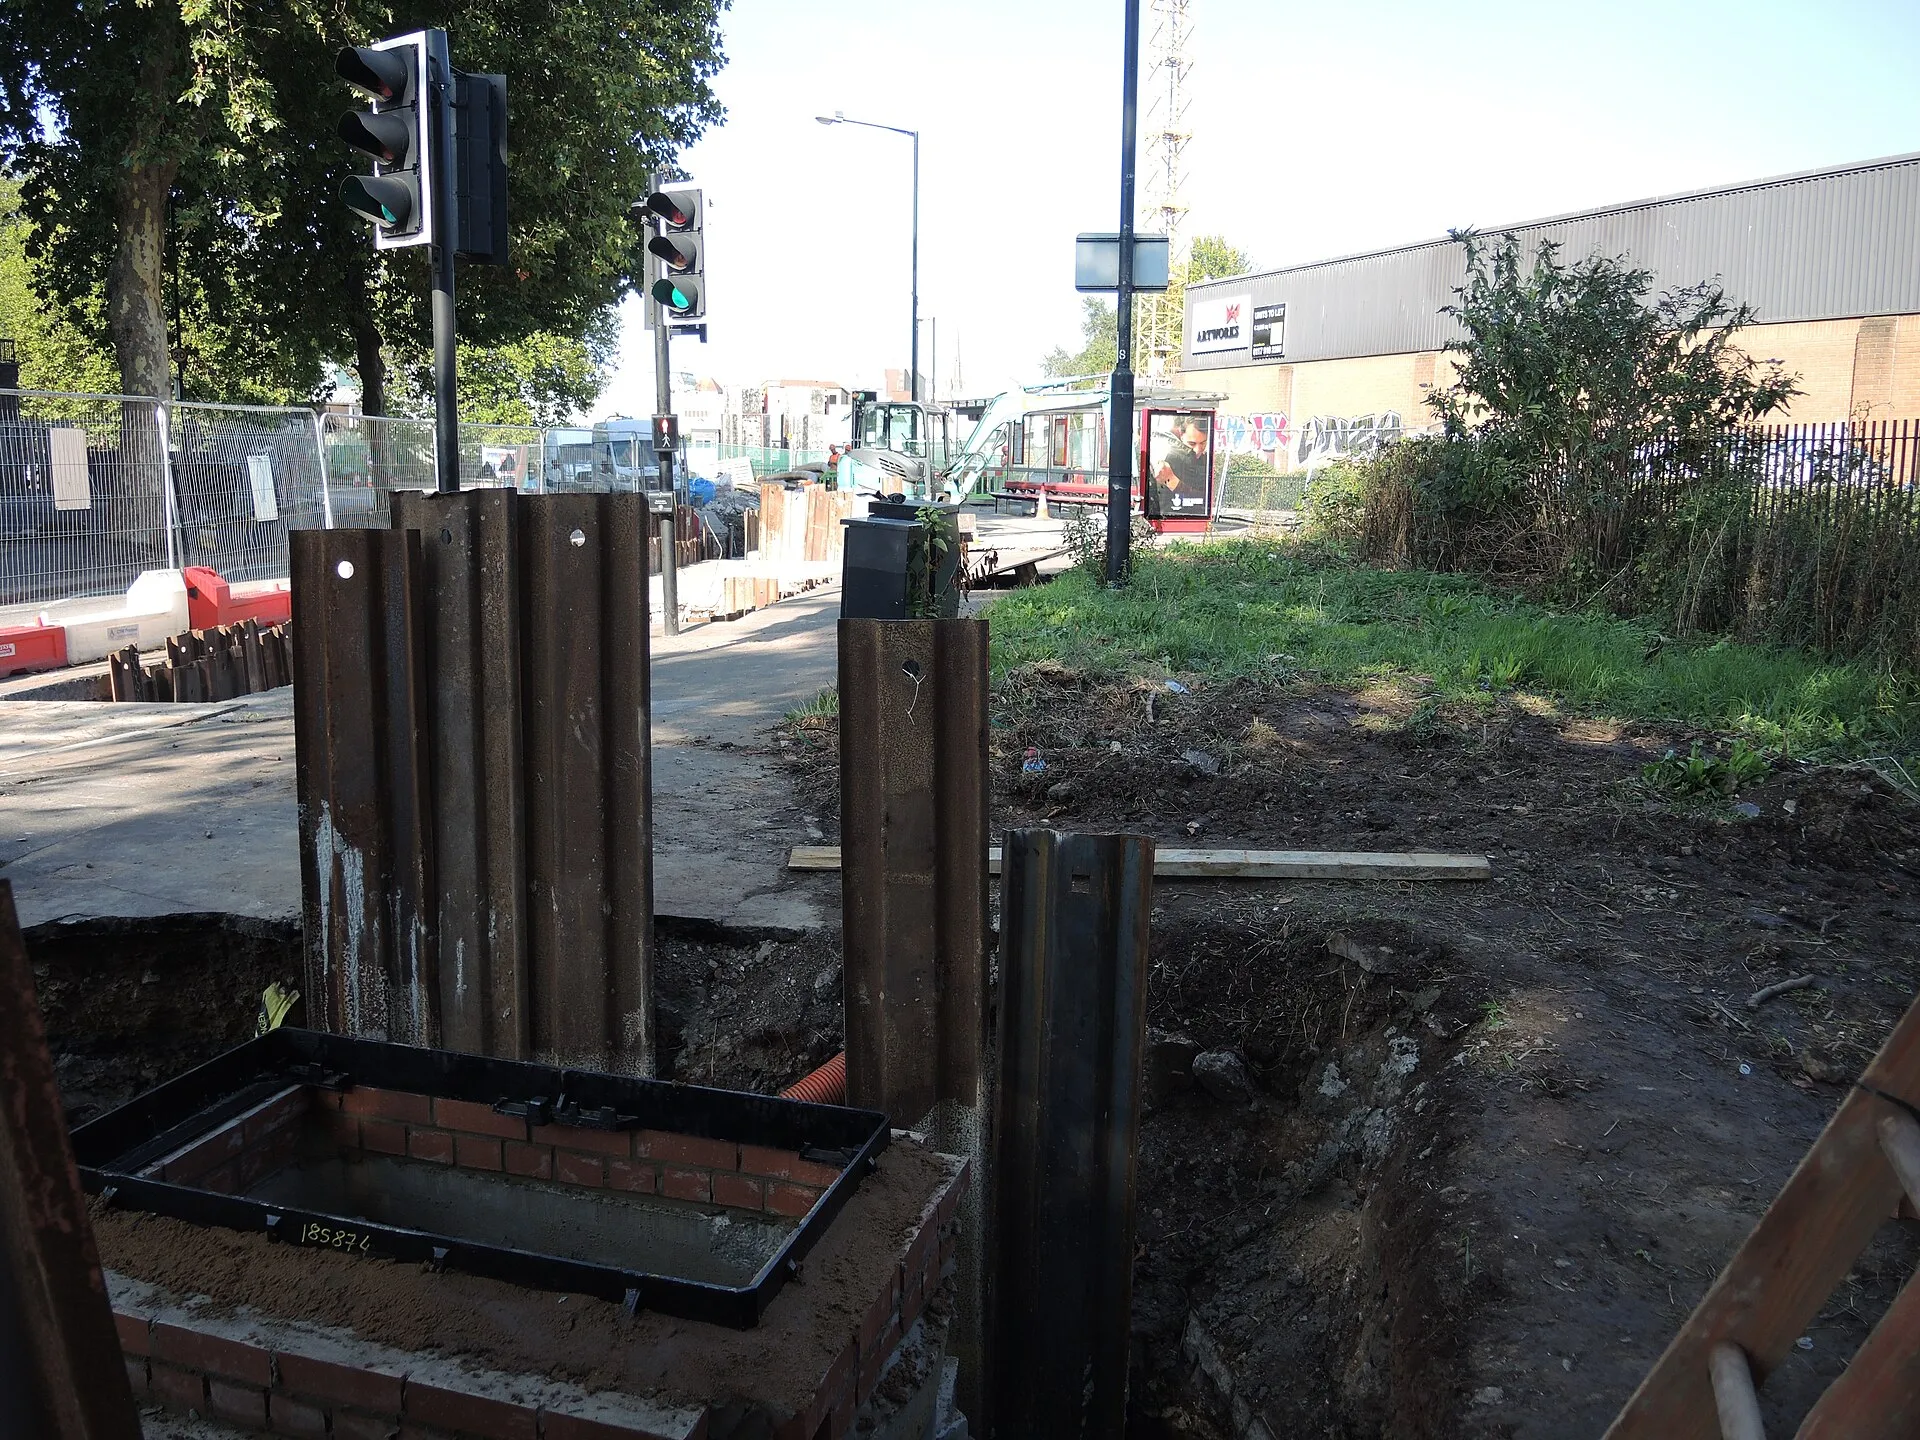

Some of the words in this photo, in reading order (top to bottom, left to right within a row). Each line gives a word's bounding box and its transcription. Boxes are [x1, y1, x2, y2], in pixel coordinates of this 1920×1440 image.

[1268, 309, 1274, 317] TO
[1275, 308, 1284, 316] LET
[1197, 325, 1239, 343] ARTWORKS
